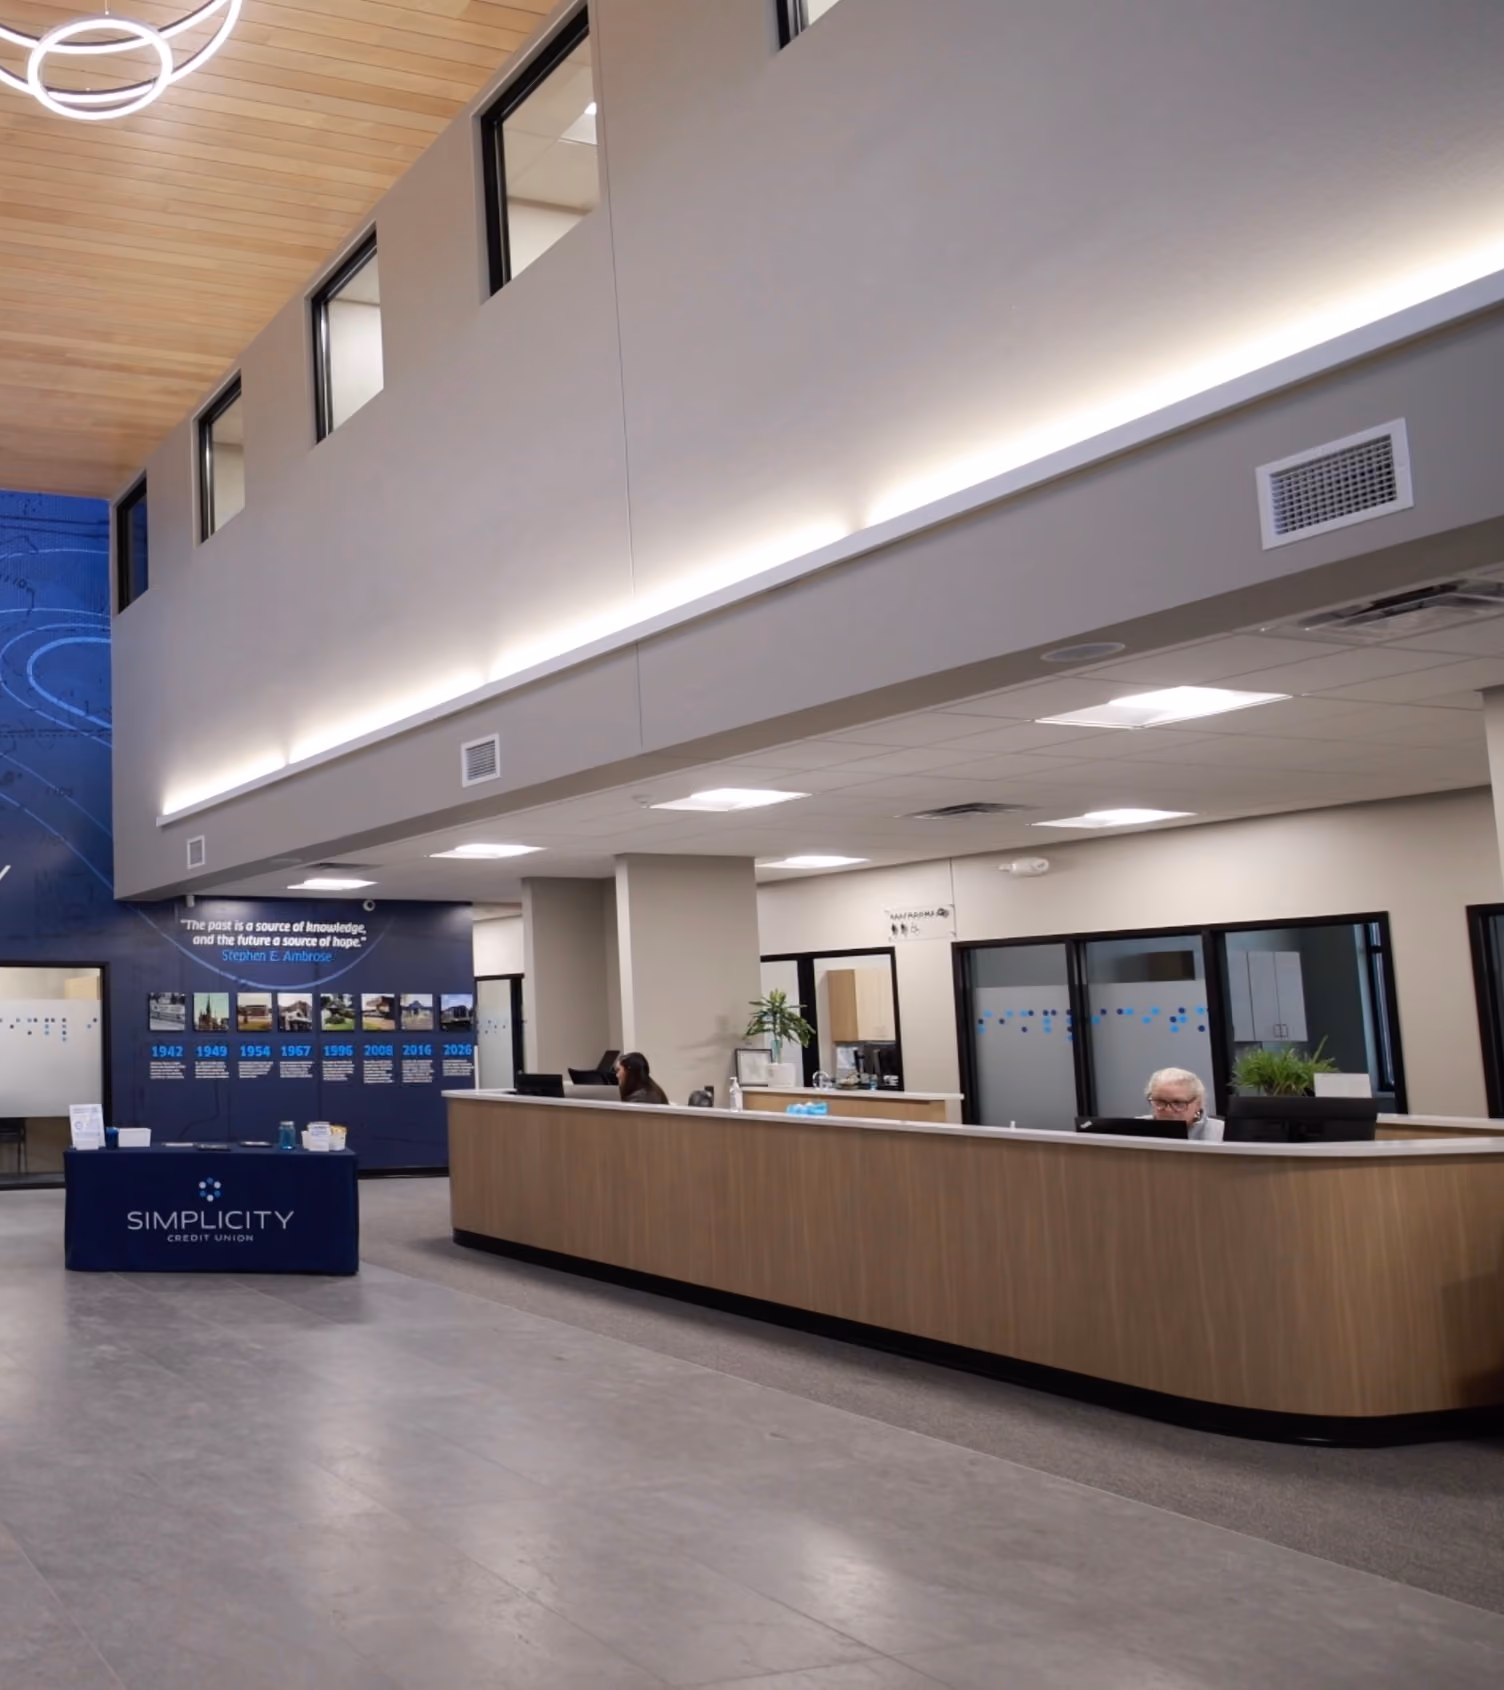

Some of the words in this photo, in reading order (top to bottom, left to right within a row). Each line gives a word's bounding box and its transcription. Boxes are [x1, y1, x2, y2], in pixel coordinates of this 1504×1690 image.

[181, 919, 205, 931] "The
[208, 920, 232, 933] past
[234, 920, 244, 931] is
[246, 922, 253, 931] a
[255, 921, 291, 932] source
[293, 921, 304, 932] of
[306, 921, 367, 935] knowledge,
[193, 934, 214, 945] and
[217, 934, 234, 945] the
[237, 934, 271, 946] future
[272, 936, 280, 946] a
[282, 936, 317, 947] source
[319, 935, 331, 947] of
[332, 936, 367, 949] hope."
[222, 950, 265, 963] Stephen
[283, 950, 332, 962] Ambrose
[151, 1045, 184, 1057] 1942
[196, 1045, 228, 1057] 1949
[240, 1045, 271, 1057] 1954
[281, 1045, 311, 1057] 1967
[402, 1044, 431, 1056] 2016
[126, 1210, 295, 1231] SIMPLICITY
[167, 1234, 210, 1243] CREDIT
[214, 1234, 255, 1243] UNION
